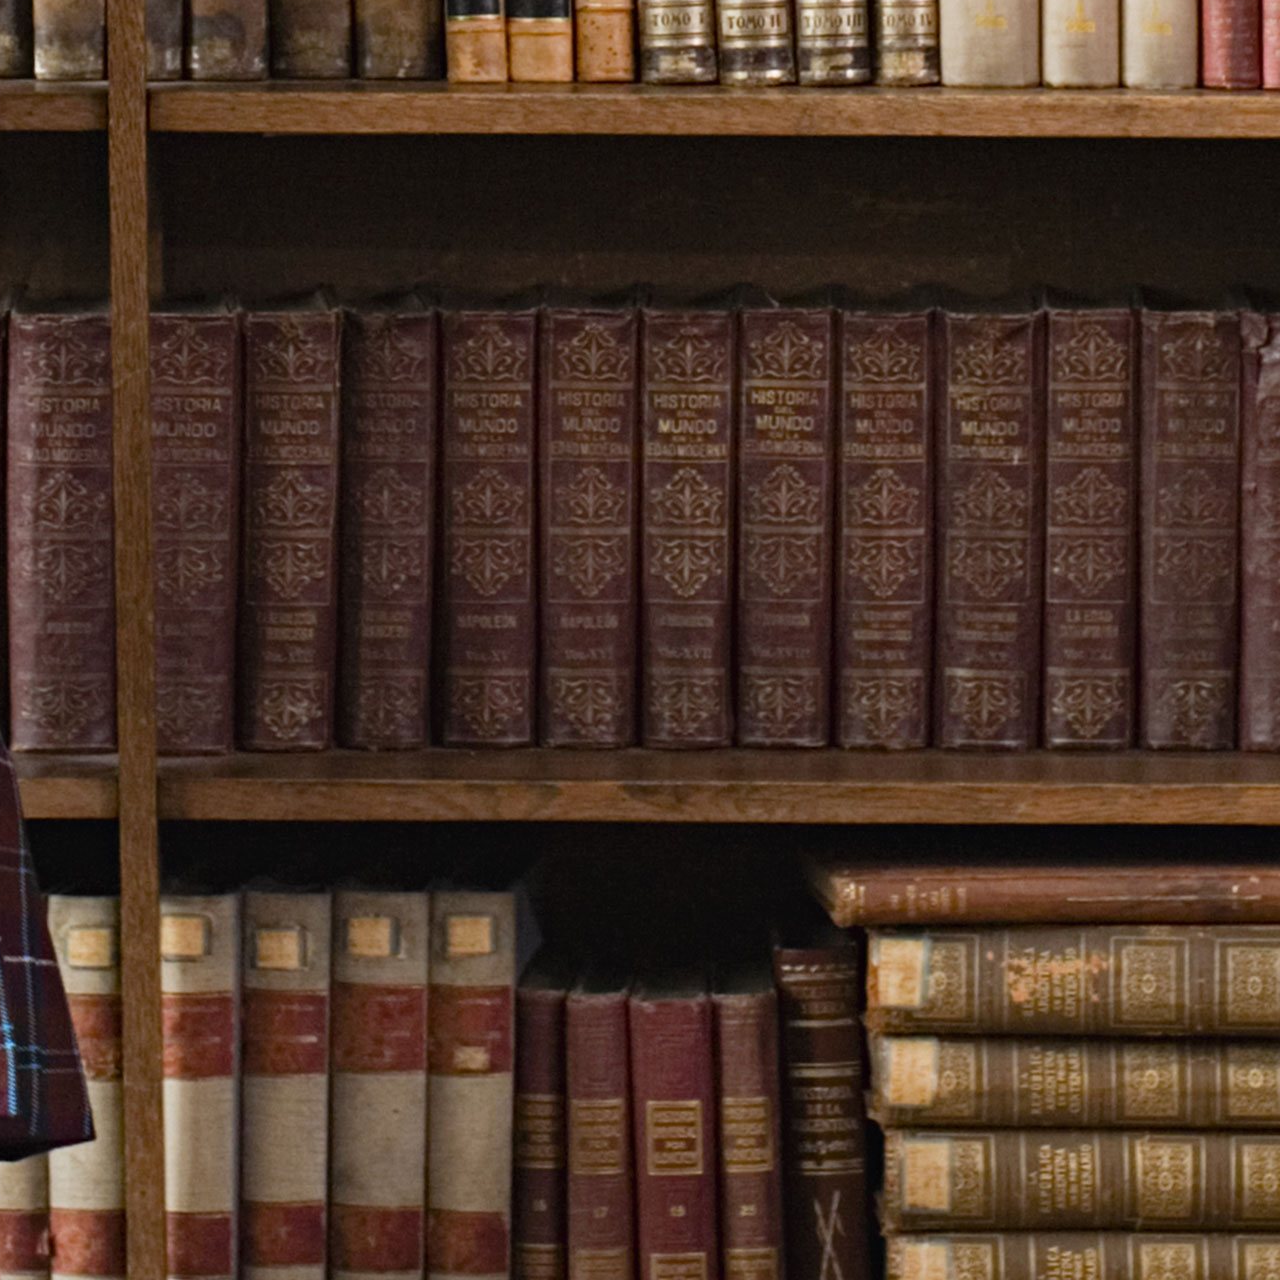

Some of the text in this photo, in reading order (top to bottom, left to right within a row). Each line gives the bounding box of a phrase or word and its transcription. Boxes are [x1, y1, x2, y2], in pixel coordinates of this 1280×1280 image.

[652, 13, 691, 28] TOMO
[727, 15, 766, 30] TOMO
[803, 14, 843, 29] TOMO
[453, 392, 523, 408] HISTORIA
[557, 391, 624, 407] HISTORIA
[653, 394, 721, 409] HISTORIA
[751, 390, 819, 406] HISTORIA
[850, 394, 918, 409] HISTORIA
[956, 395, 1020, 411] HISTORIA
[1058, 393, 1123, 408] HISTORIA
[458, 418, 518, 433] MUNDO
[562, 417, 620, 433] MUNDO
[658, 419, 717, 434] MUNDO
[755, 416, 815, 431] MUNDO
[856, 419, 913, 434] MUNDO
[960, 422, 1018, 437] MUNDO
[1062, 419, 1120, 434] MUNDO
